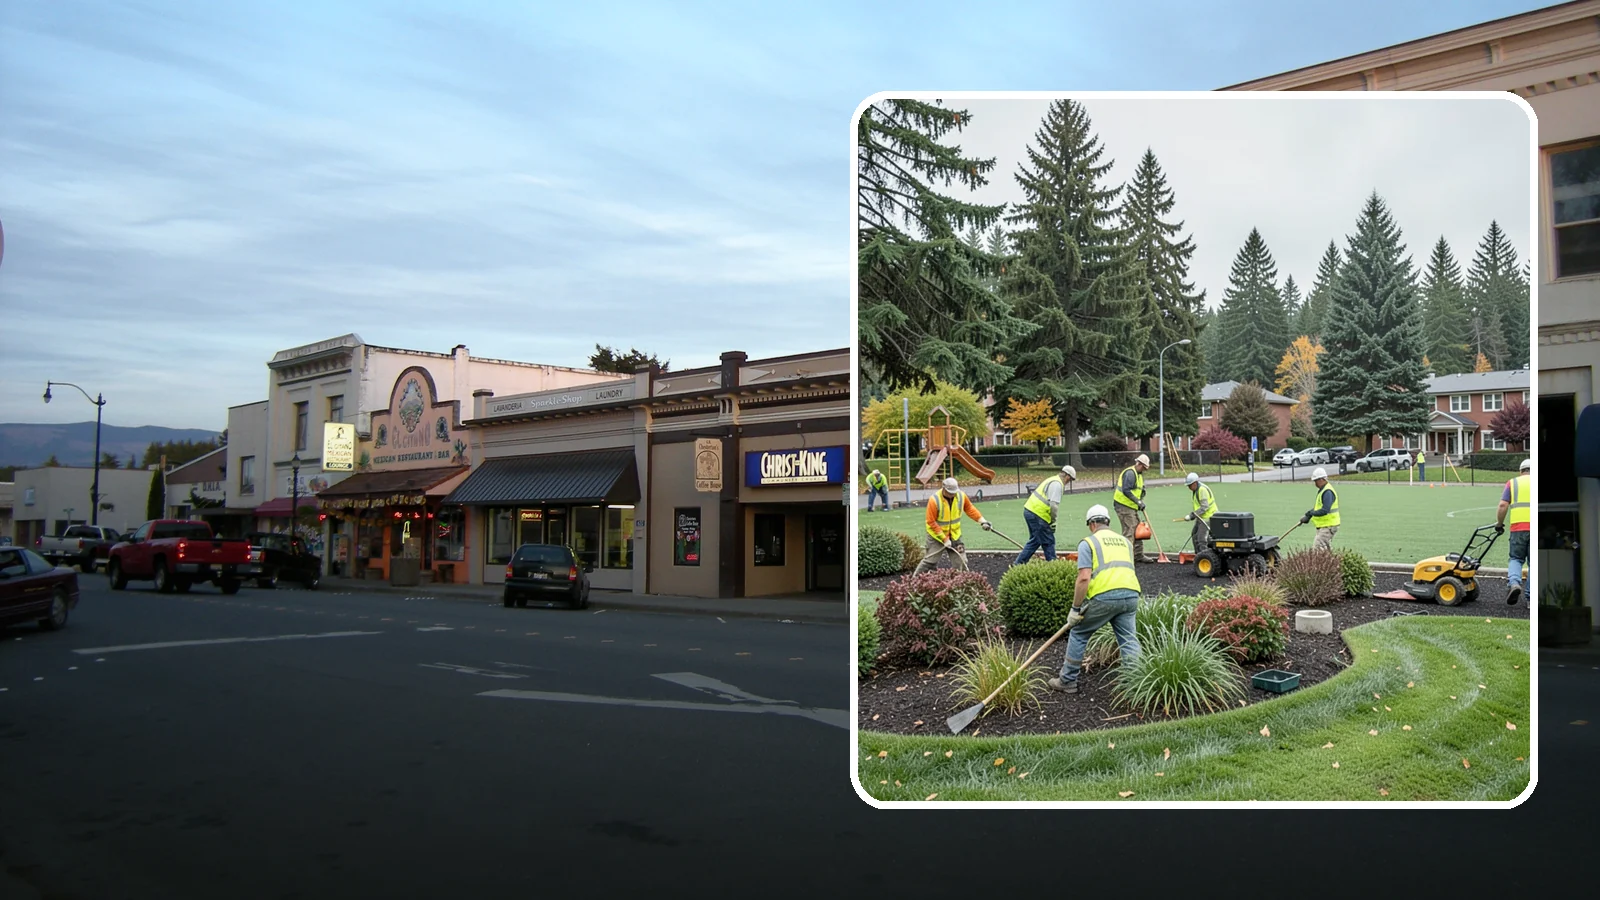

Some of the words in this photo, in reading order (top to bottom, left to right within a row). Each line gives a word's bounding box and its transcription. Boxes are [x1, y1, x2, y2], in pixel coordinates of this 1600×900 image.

[595, 389, 623, 400] LAUNDRY
[493, 402, 522, 413] LAVANDERIA
[373, 455, 396, 465] MEXICAN
[397, 452, 433, 462] RESTAURANT
[438, 450, 450, 459] BAR
[760, 452, 798, 478] CHRIST
[799, 450, 827, 476] KING
